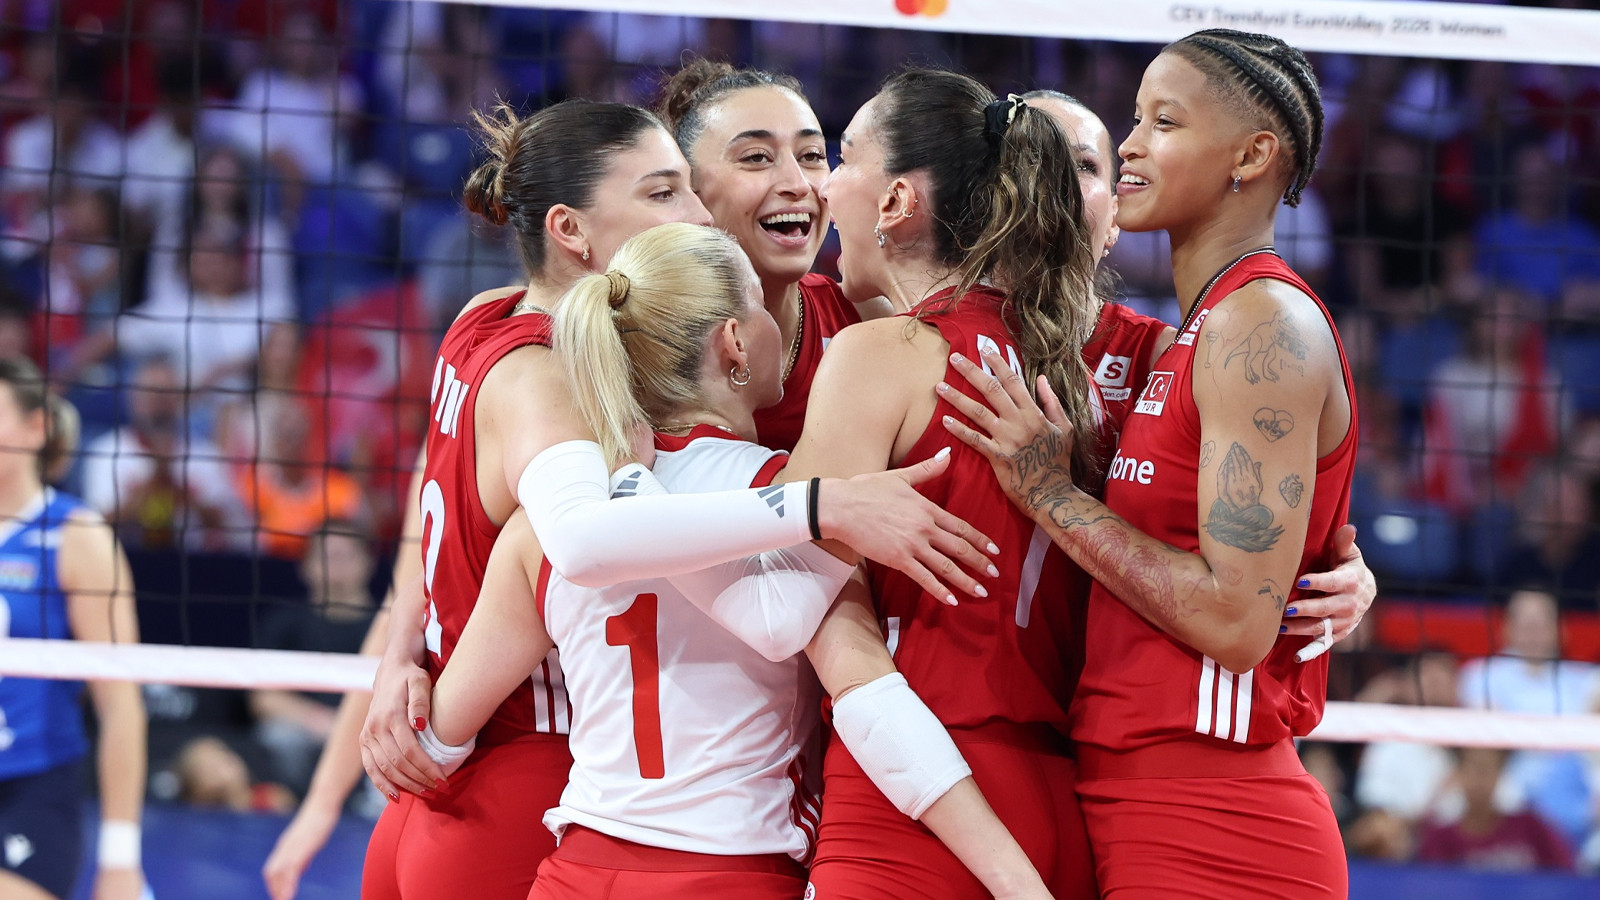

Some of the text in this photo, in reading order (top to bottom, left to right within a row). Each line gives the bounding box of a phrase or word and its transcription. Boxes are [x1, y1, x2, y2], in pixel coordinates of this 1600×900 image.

[1170, 5, 1205, 22] CEV
[1213, 7, 1288, 28] Trendyol
[1292, 11, 1384, 35] EuroVolley
[1439, 19, 1506, 36] Women
[1103, 361, 1124, 380] S
[1142, 402, 1157, 413] TUR
[605, 592, 666, 780] 1
